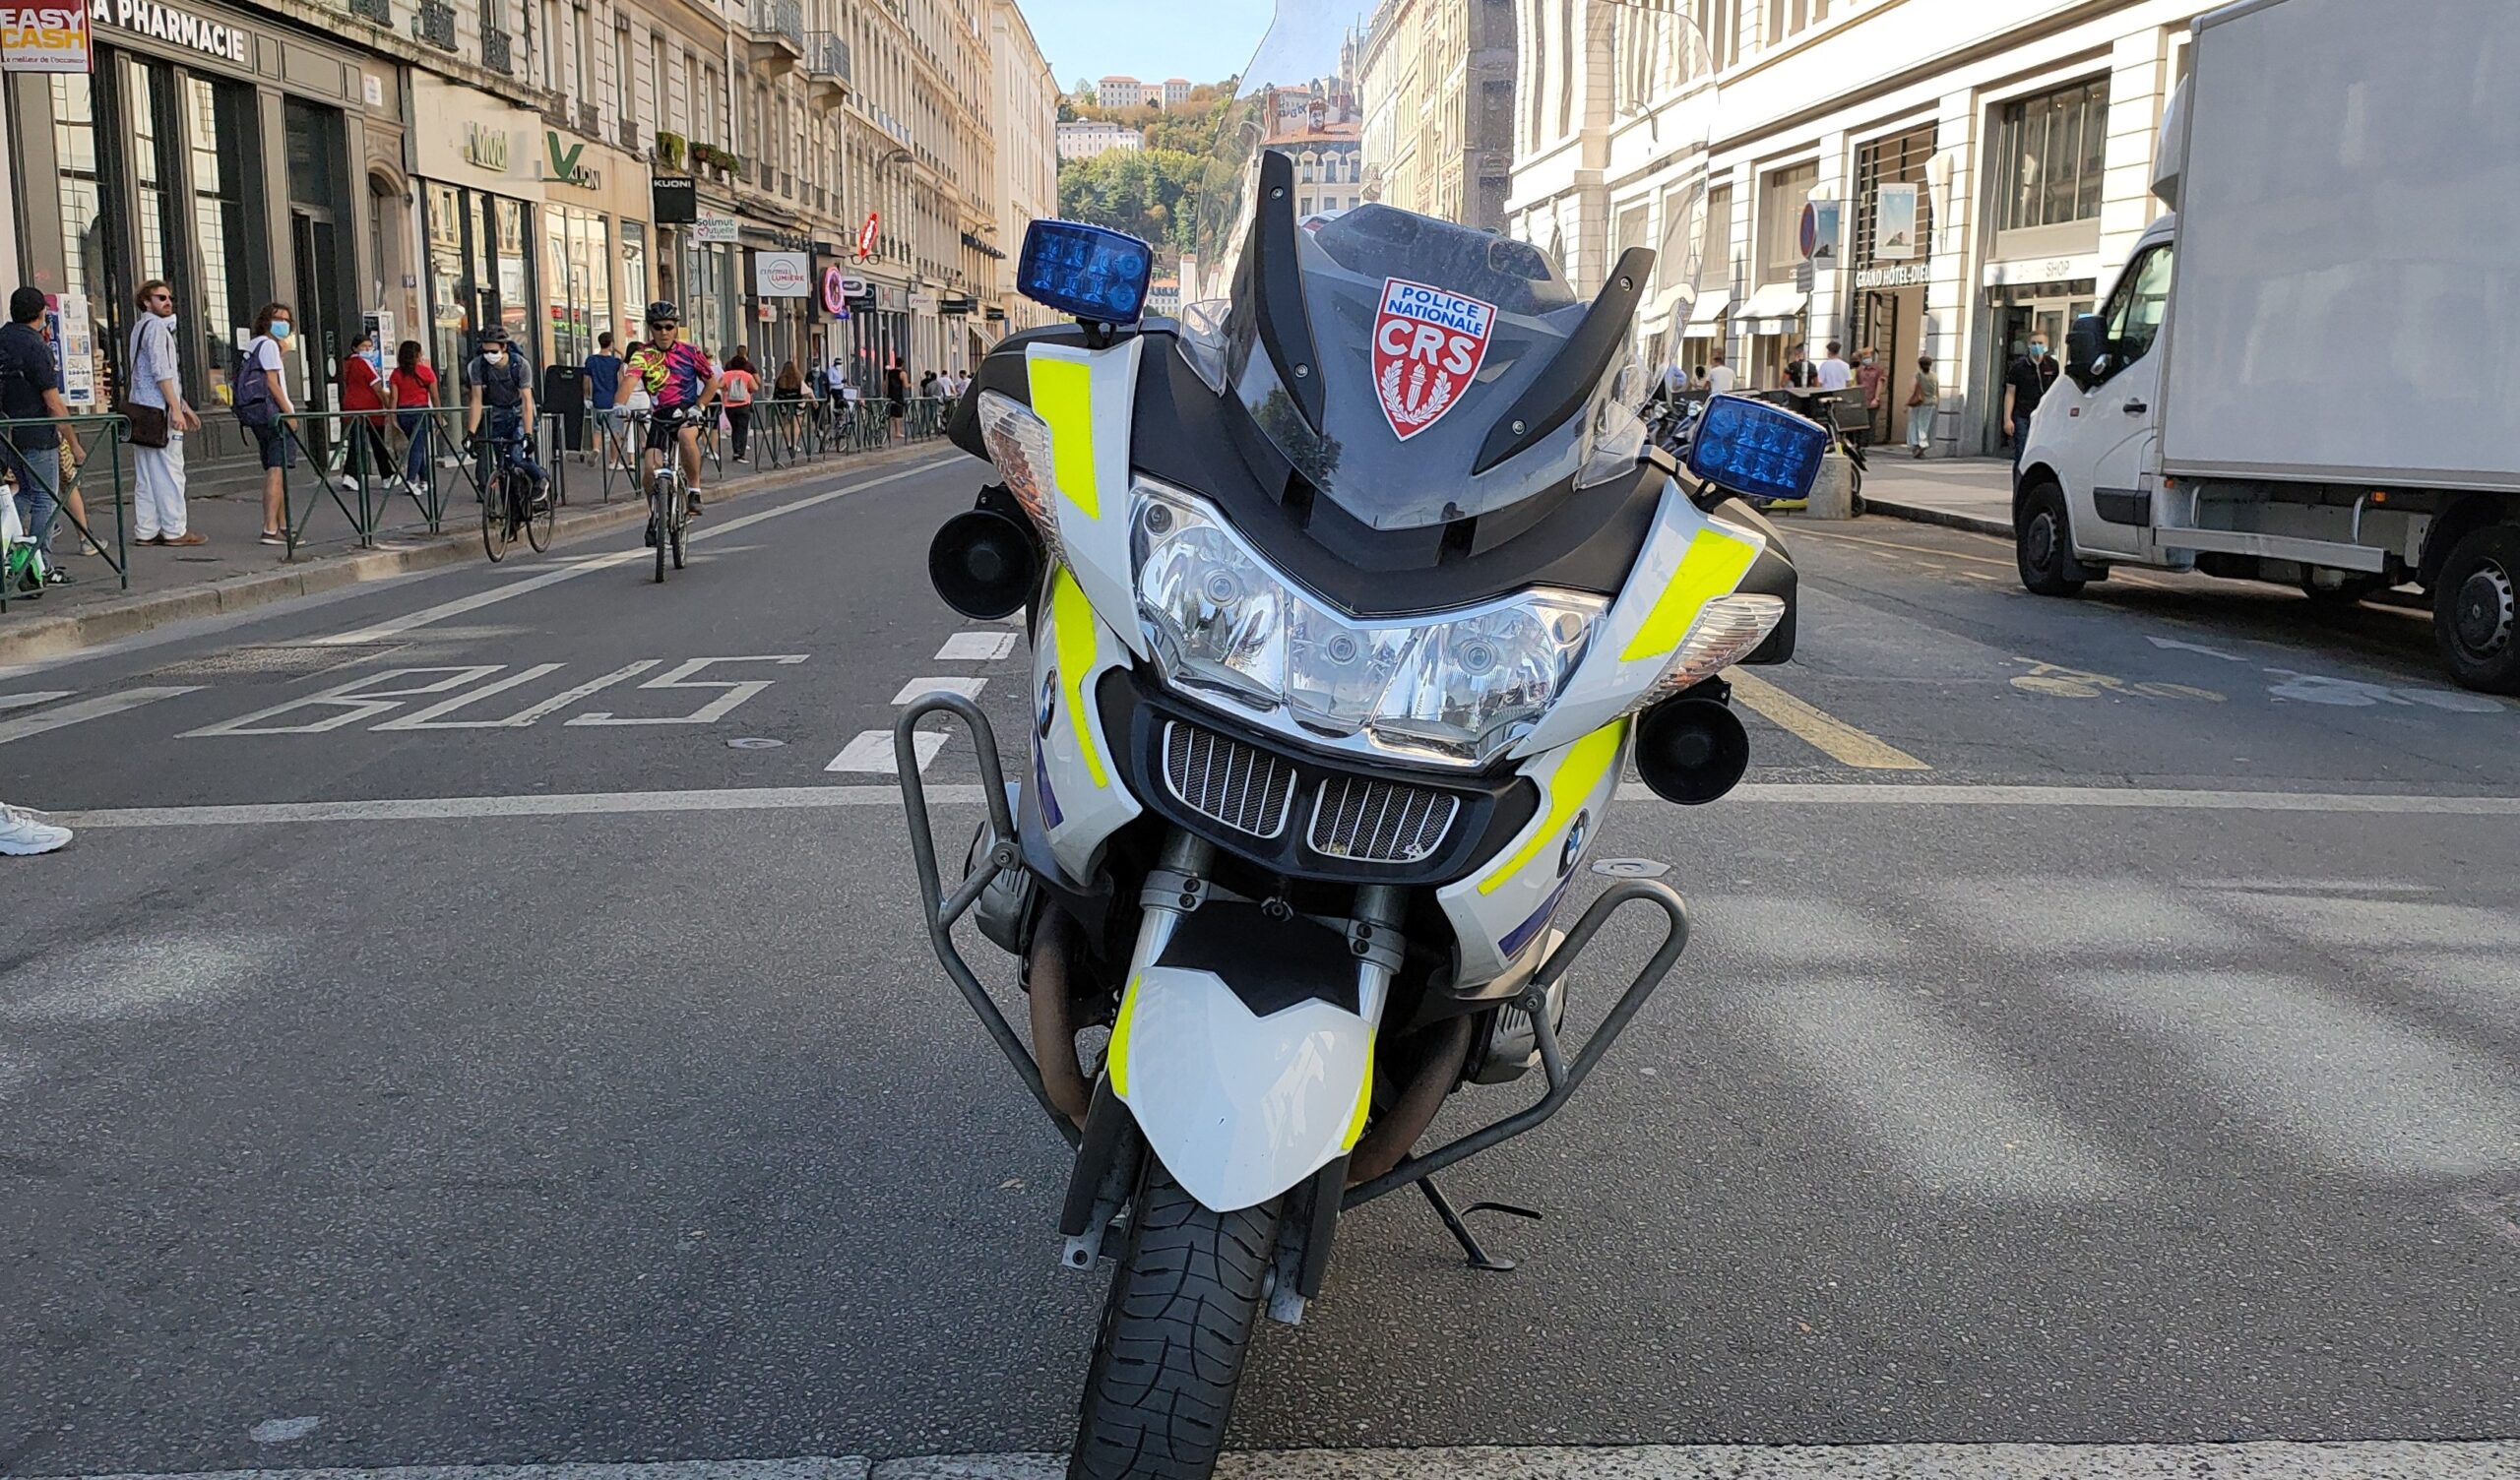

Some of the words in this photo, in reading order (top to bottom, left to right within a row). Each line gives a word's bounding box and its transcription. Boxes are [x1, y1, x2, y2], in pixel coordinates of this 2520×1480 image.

[0, 8, 84, 33] EASY
[117, 0, 245, 62] PHARMACIE
[2, 28, 86, 49] CASH
[654, 179, 691, 188] KUONI
[1856, 269, 1883, 288] GRAND
[2046, 260, 2070, 278] SHOP
[1402, 286, 1480, 319] POLICE
[1388, 299, 1482, 337] NATIONALE
[1378, 319, 1476, 375] CRS
[173, 654, 810, 739] BUS
